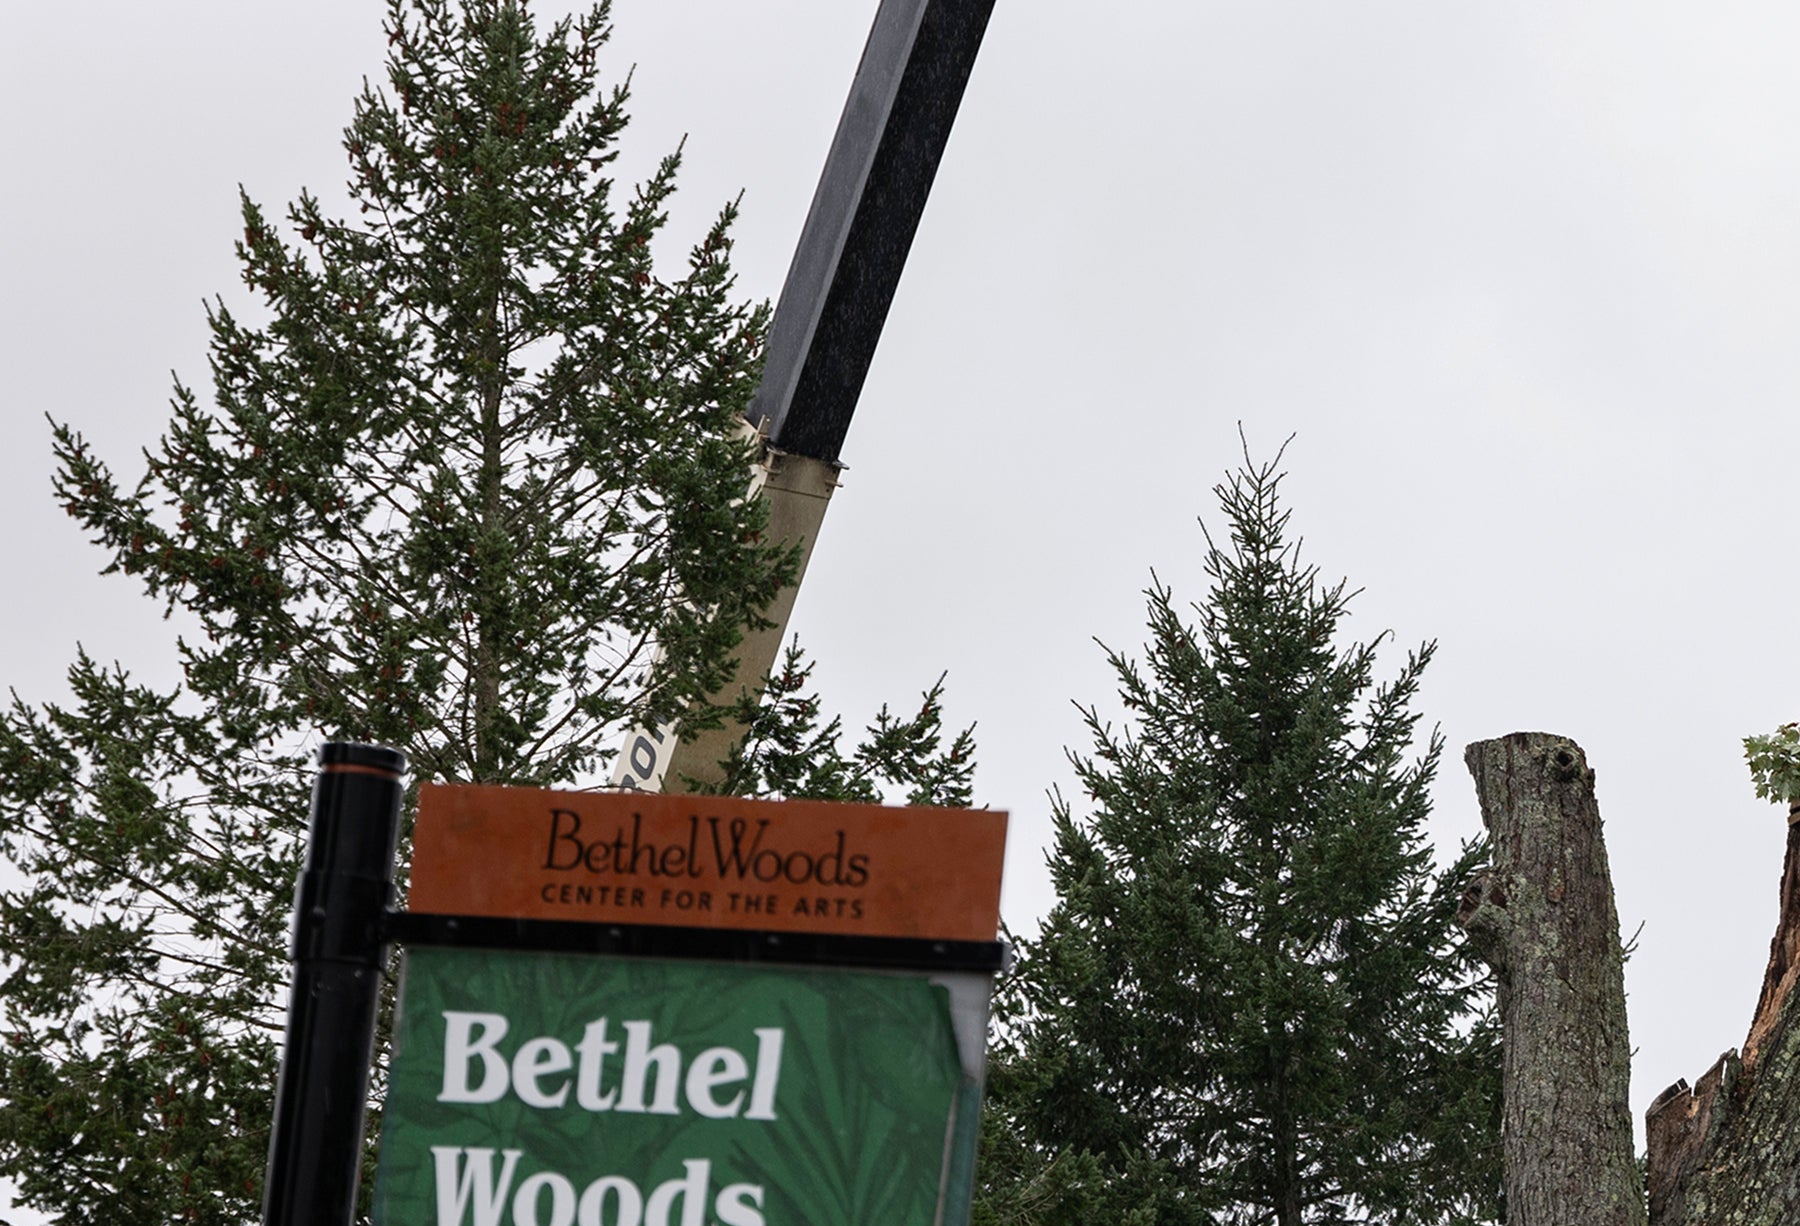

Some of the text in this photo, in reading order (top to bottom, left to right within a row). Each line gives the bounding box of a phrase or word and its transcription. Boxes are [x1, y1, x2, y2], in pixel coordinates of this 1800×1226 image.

[541, 809, 870, 888] Bethel Woods
[541, 882, 865, 920] CENTER FOR THE ARTS
[436, 1010, 784, 1121] Bethel
